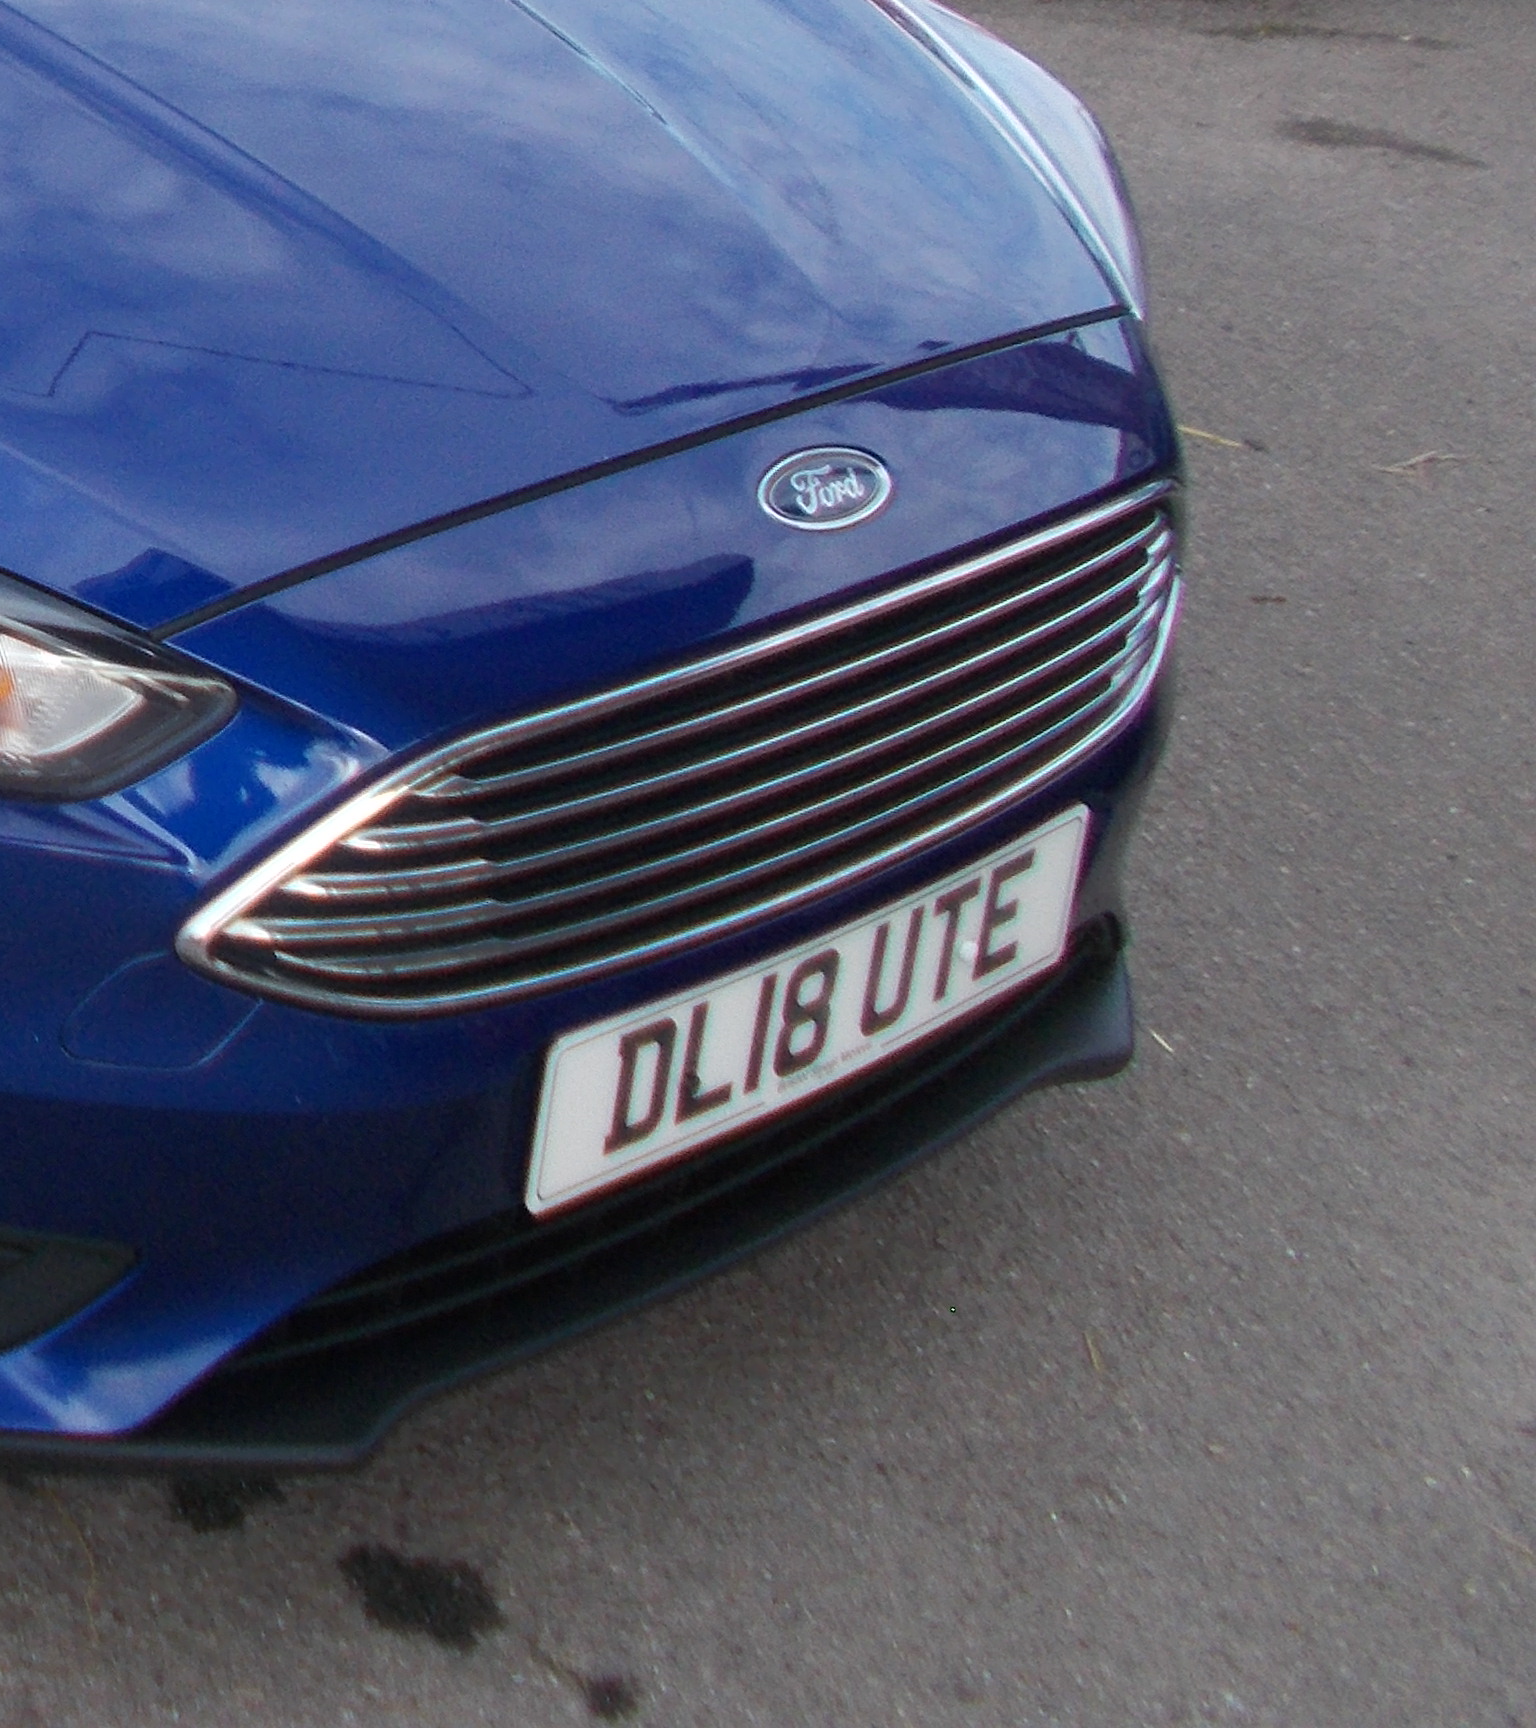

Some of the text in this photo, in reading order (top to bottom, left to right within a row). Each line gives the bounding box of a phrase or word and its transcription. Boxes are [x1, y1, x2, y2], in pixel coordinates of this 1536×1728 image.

[790, 463, 866, 515] Ford
[603, 849, 1036, 1156] DL18 UTE
